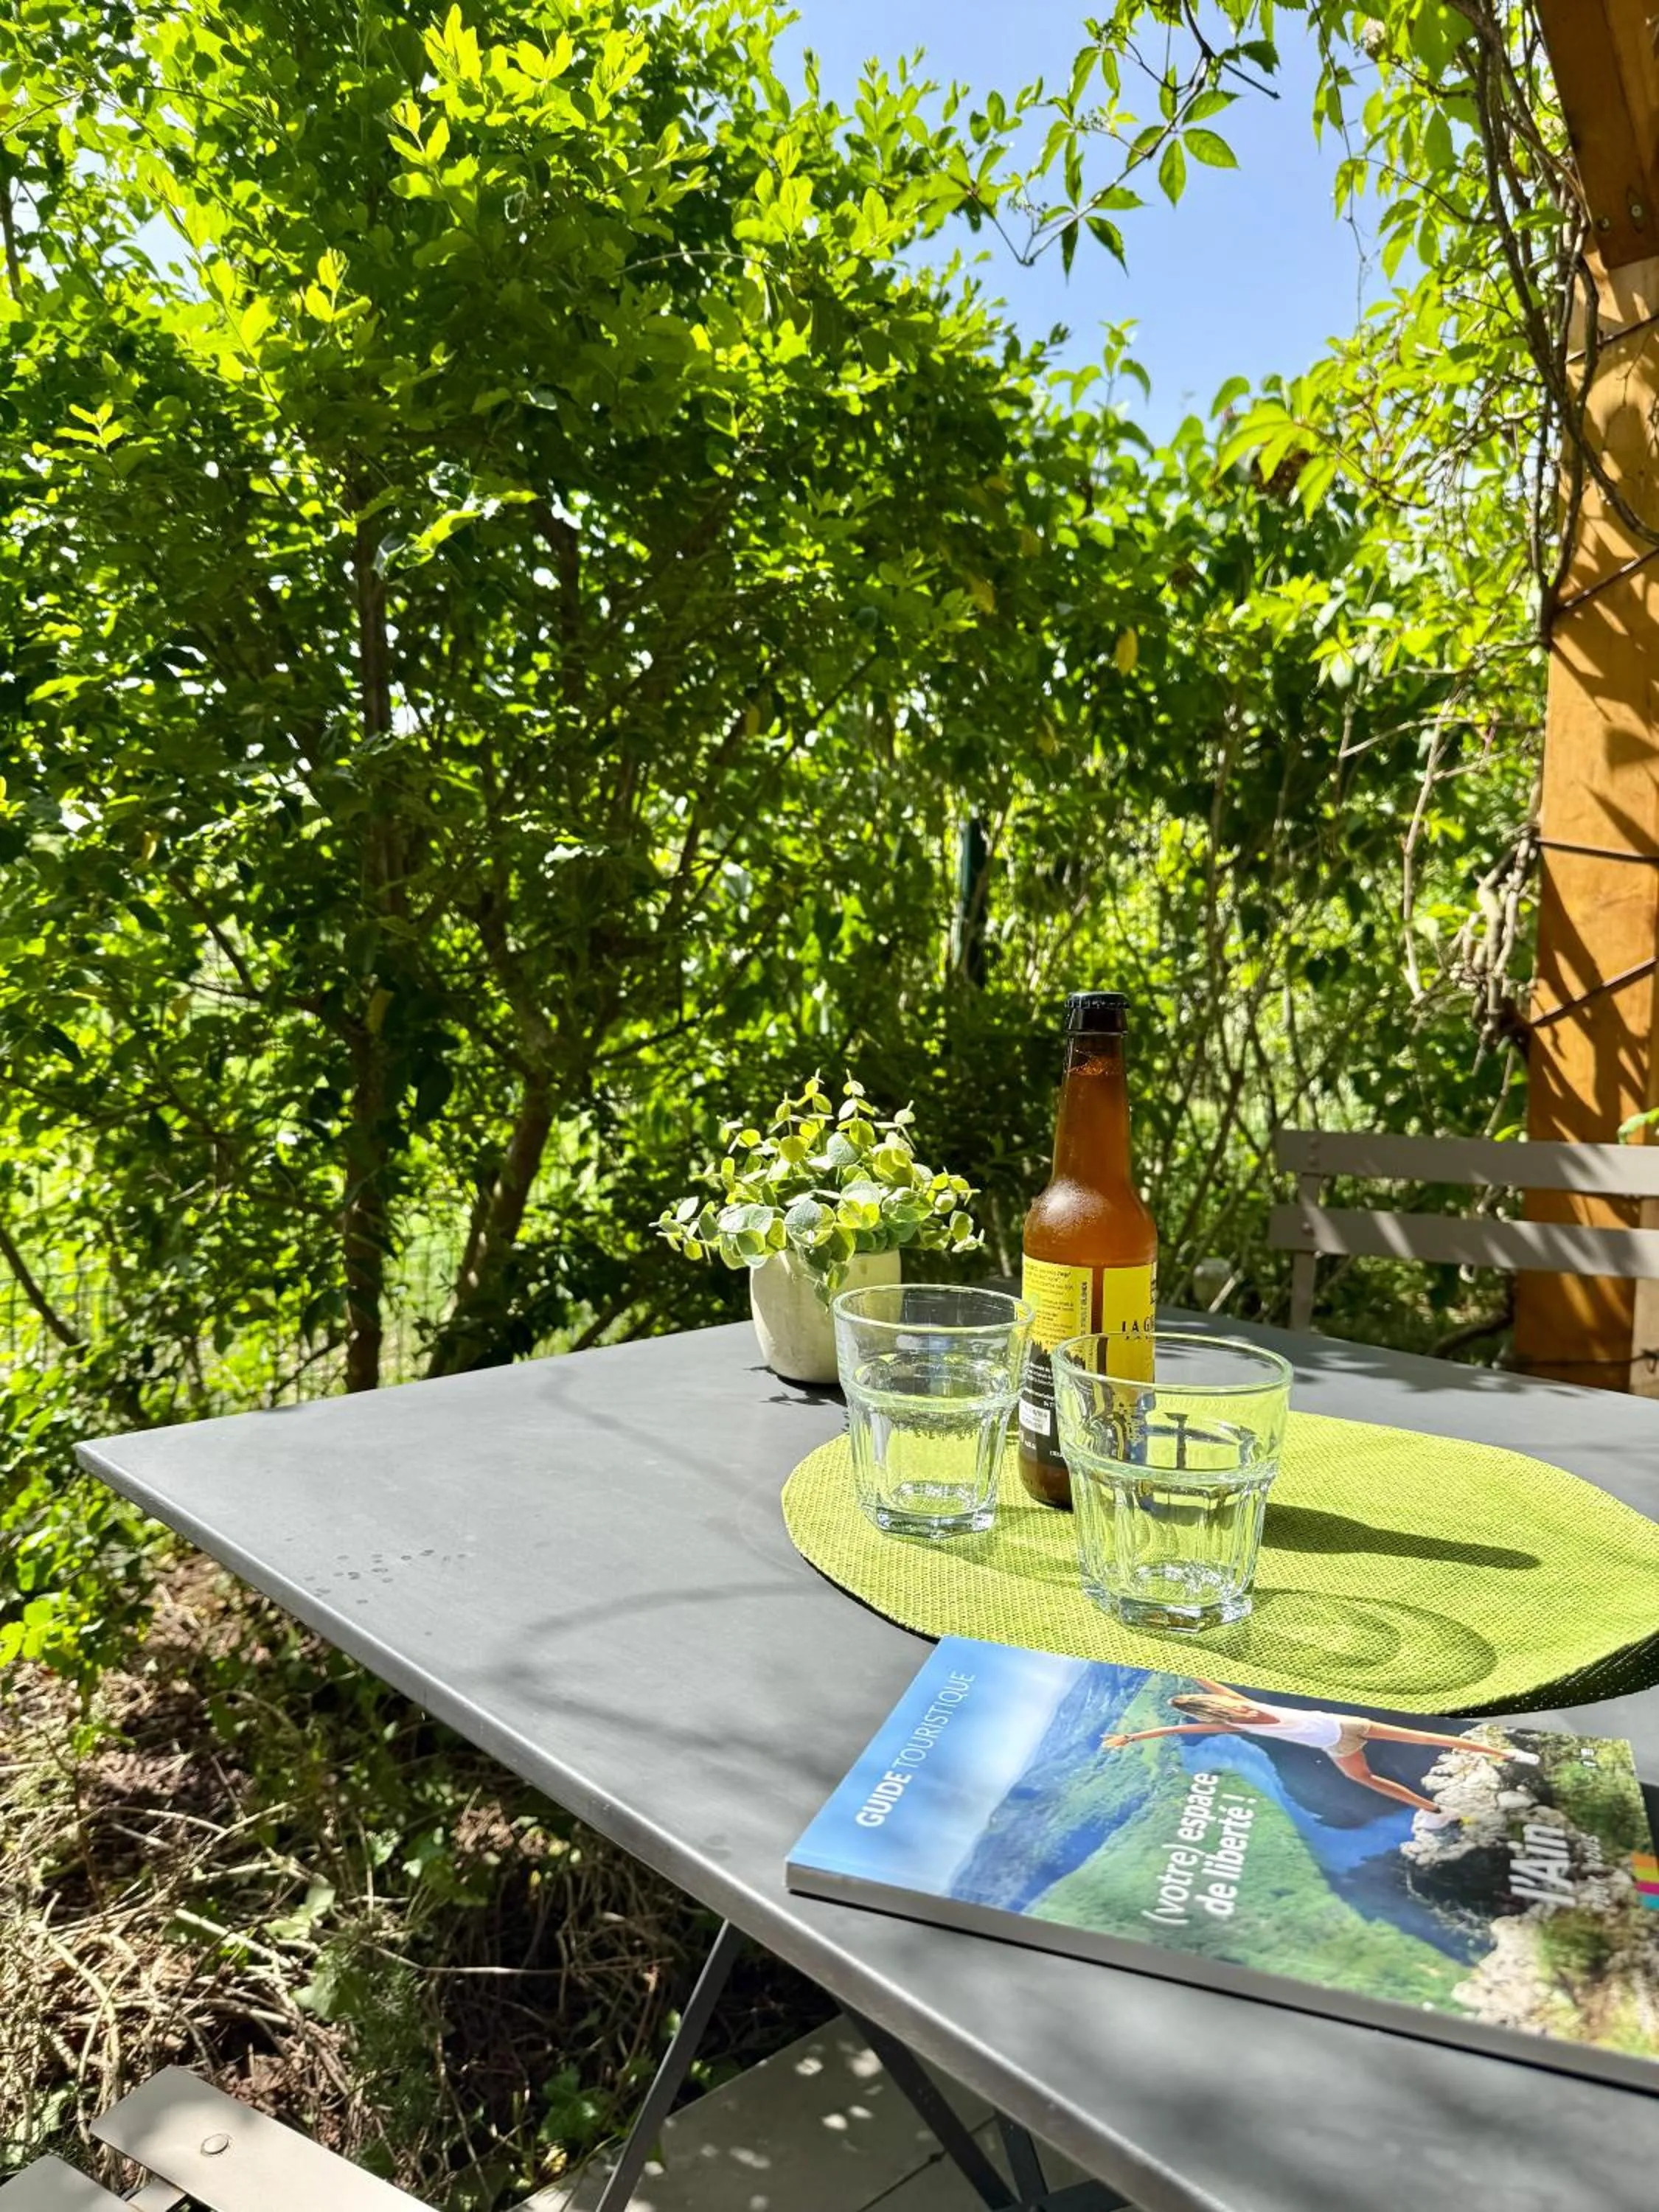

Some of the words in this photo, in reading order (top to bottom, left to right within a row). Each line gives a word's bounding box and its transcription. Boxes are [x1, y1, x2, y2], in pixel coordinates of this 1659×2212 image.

[855, 1770, 913, 1828] GUIDE
[891, 1670, 976, 1769] TOURISTIQUE
[1141, 1843, 1206, 1926] (votre)
[1177, 1772, 1220, 1842] espace
[1201, 1804, 1255, 1880] liberté
[1508, 1823, 1576, 1907] l'Ain
[1194, 1882, 1239, 1919] de
